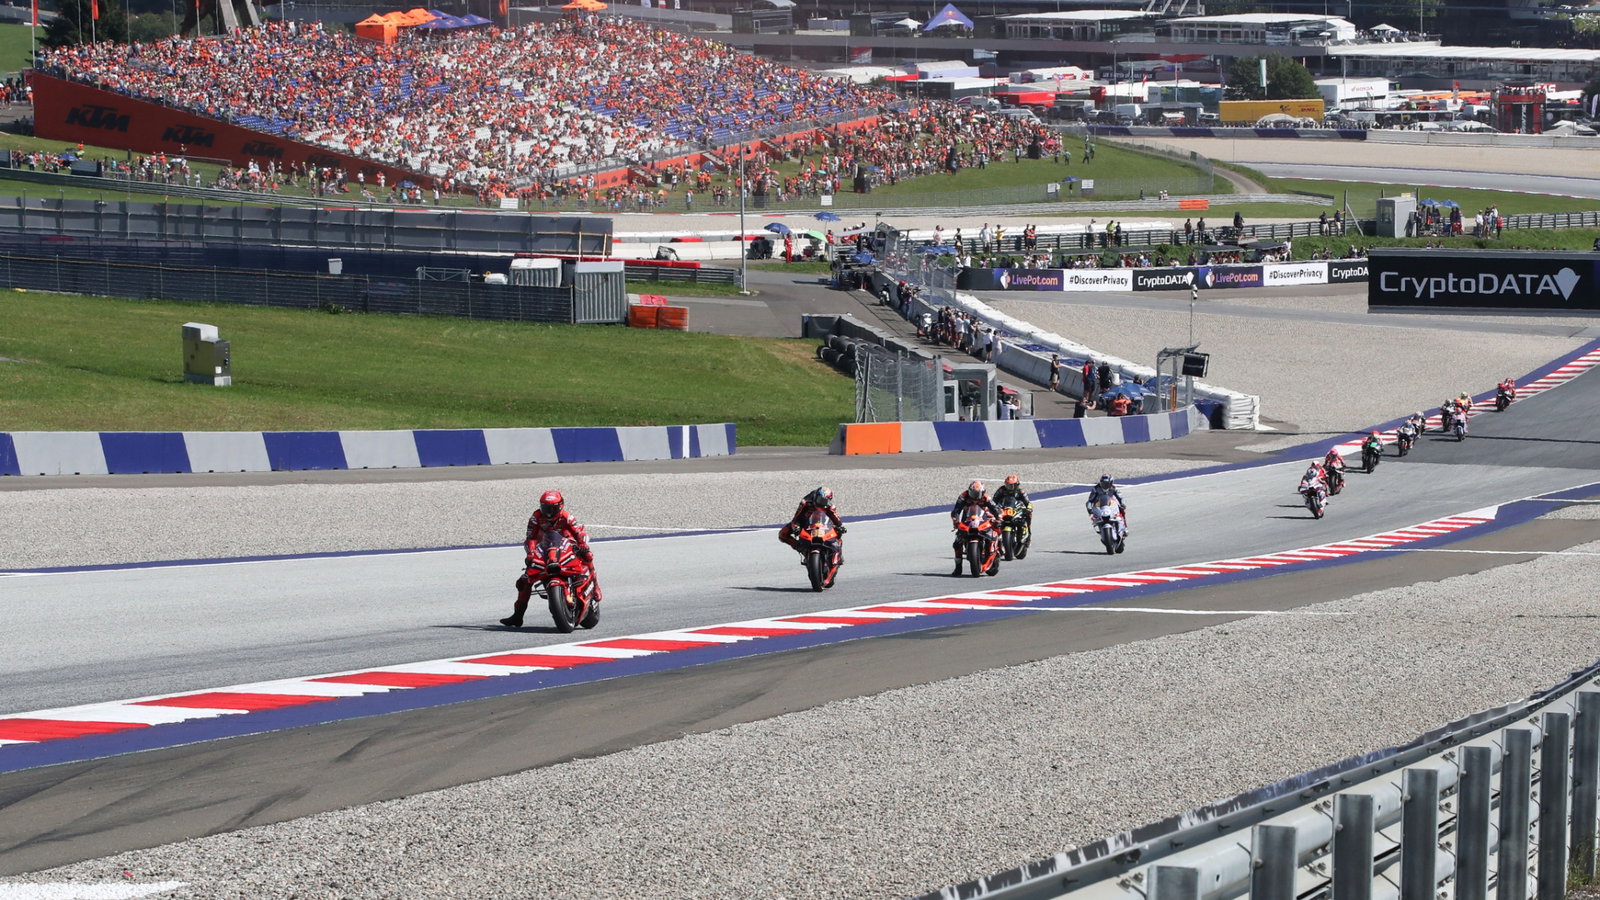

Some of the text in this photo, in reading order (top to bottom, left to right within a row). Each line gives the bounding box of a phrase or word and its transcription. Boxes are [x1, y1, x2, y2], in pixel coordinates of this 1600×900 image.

[65, 104, 131, 133] KTM
[161, 124, 215, 147] KTM
[242, 140, 285, 158] KTM
[1011, 274, 1058, 286] LivePot.com
[1069, 275, 1128, 287] #DiscoverPrivacy
[1138, 274, 1188, 288] CryptoDATA
[1215, 272, 1258, 283] LivePot.com
[1268, 268, 1324, 280] #DiscoverPrivacy
[1379, 271, 1560, 299] CryptoDATA
